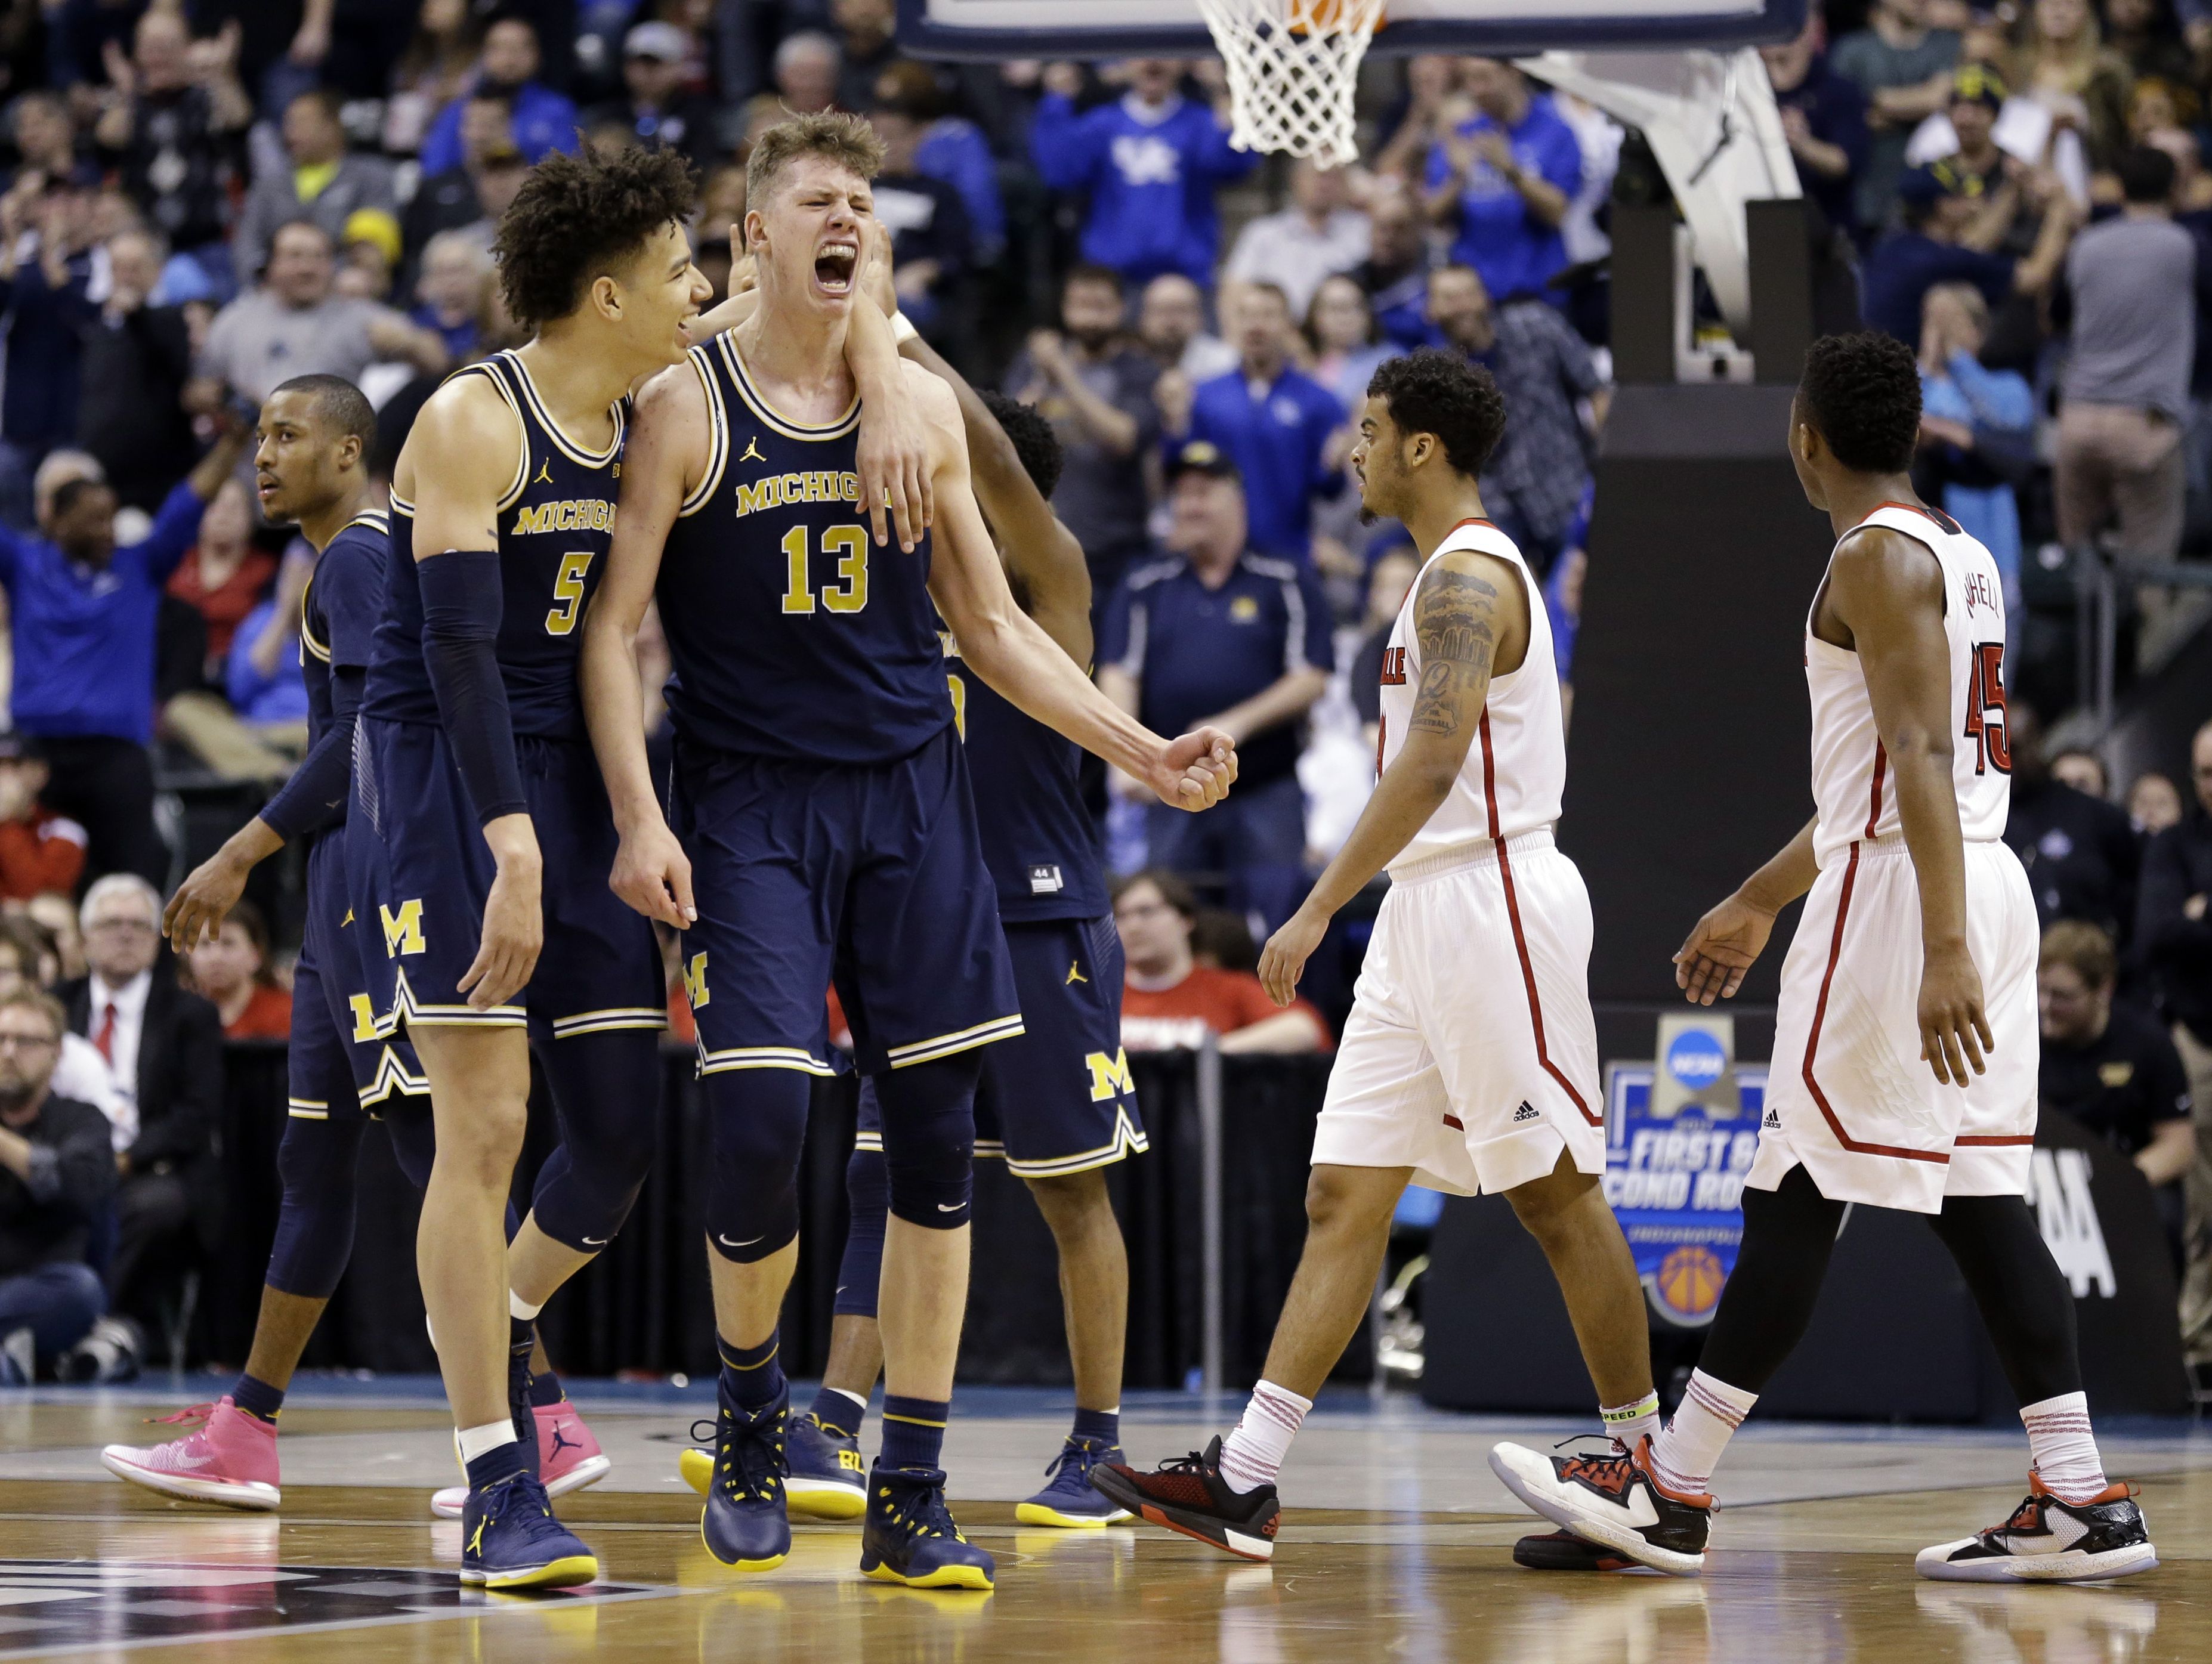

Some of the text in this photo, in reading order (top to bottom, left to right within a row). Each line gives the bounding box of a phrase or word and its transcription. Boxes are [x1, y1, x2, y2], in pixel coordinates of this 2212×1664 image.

[511, 499, 617, 536] MICHIGA
[736, 471, 892, 518] MICHIG
[545, 552, 595, 635] 5
[781, 524, 869, 614] 13
[1964, 641, 2011, 776] 45
[379, 898, 426, 959] M
[1085, 1046, 1135, 1103] M
[1513, 1111, 1539, 1122] adidas
[1630, 1128, 1729, 1172] FIRST
[1600, 1167, 1692, 1210] COND
